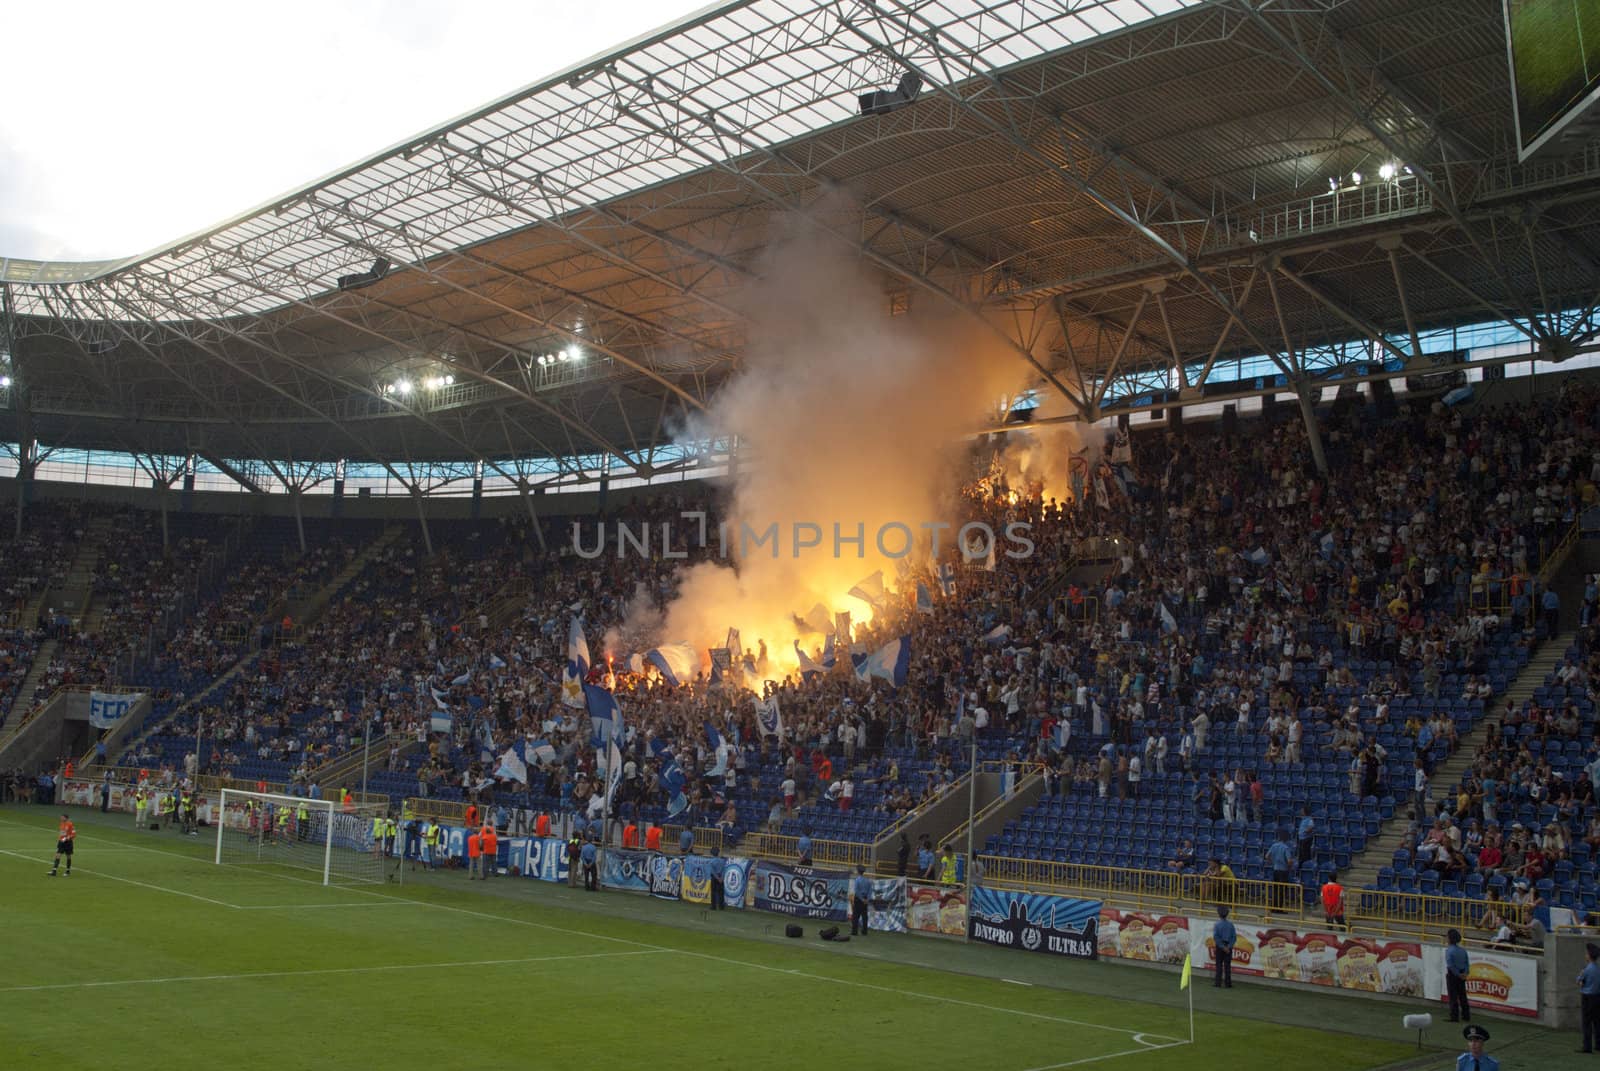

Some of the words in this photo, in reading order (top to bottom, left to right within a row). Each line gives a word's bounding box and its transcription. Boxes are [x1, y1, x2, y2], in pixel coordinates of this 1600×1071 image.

[768, 872, 832, 907] D.S.G.
[974, 923, 1014, 945] DNIPRO
[1048, 936, 1092, 957] ULTRAS
